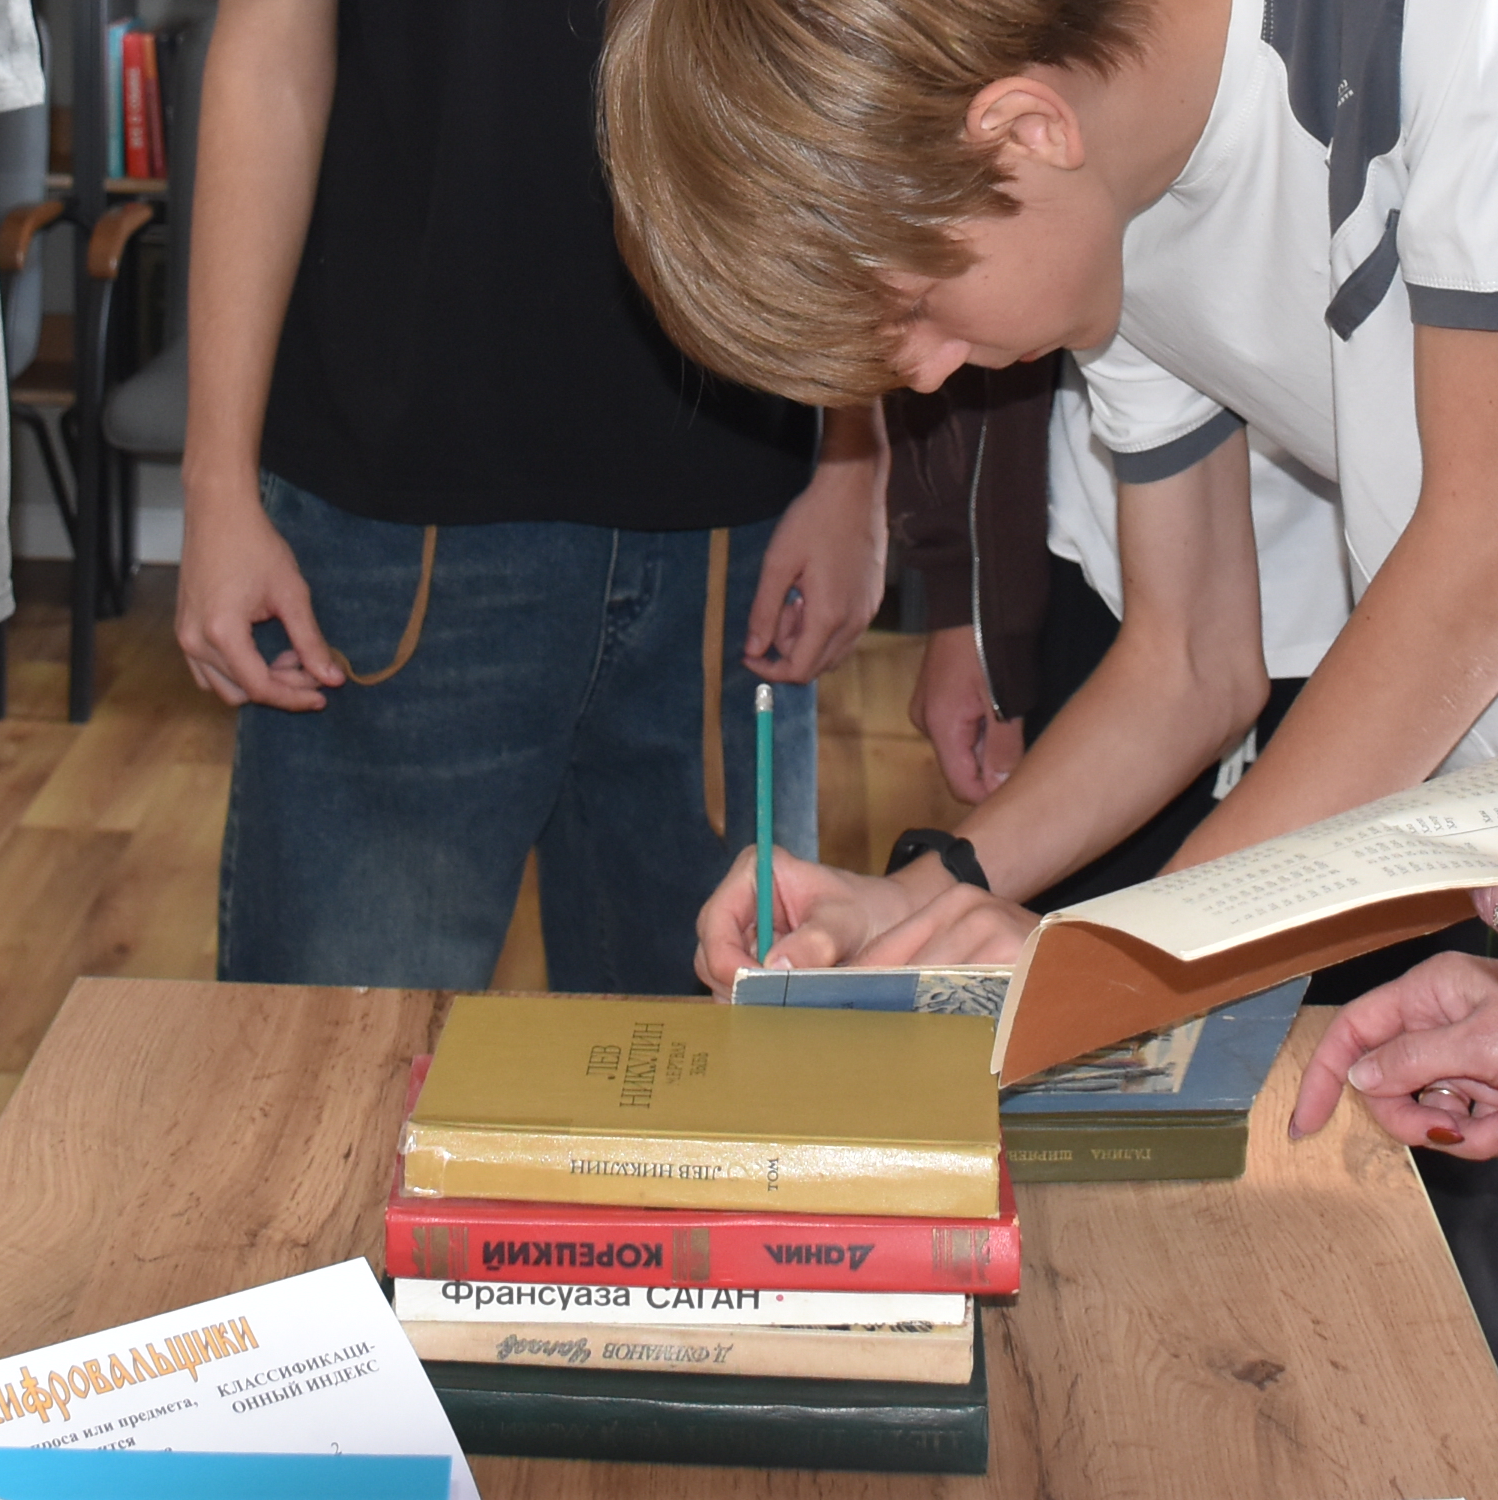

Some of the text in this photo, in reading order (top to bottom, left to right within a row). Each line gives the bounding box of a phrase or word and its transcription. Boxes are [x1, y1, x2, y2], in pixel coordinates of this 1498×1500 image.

[585, 1044, 622, 1081] ЛЕВ
[618, 1021, 665, 1110] НИКУЛИН
[569, 1159, 723, 1181] ЛЕВ НИКУЛИН
[1005, 1148, 1151, 1162] ГАЛИНА ШИРЯЕВ
[767, 1156, 780, 1192] ТОМ
[482, 1238, 664, 1273] КОРЕЦКИЙ
[441, 1279, 631, 1311] Франсуаза
[216, 1340, 377, 1399] КЛАССИФИКАЦИ-
[602, 1341, 711, 1363] ФУРМАНОВ
[231, 1359, 382, 1416] ОННЫЙ ИНДЕКС
[30, 1396, 200, 1450] проса или предмета,
[98, 1435, 137, 1451] ится
